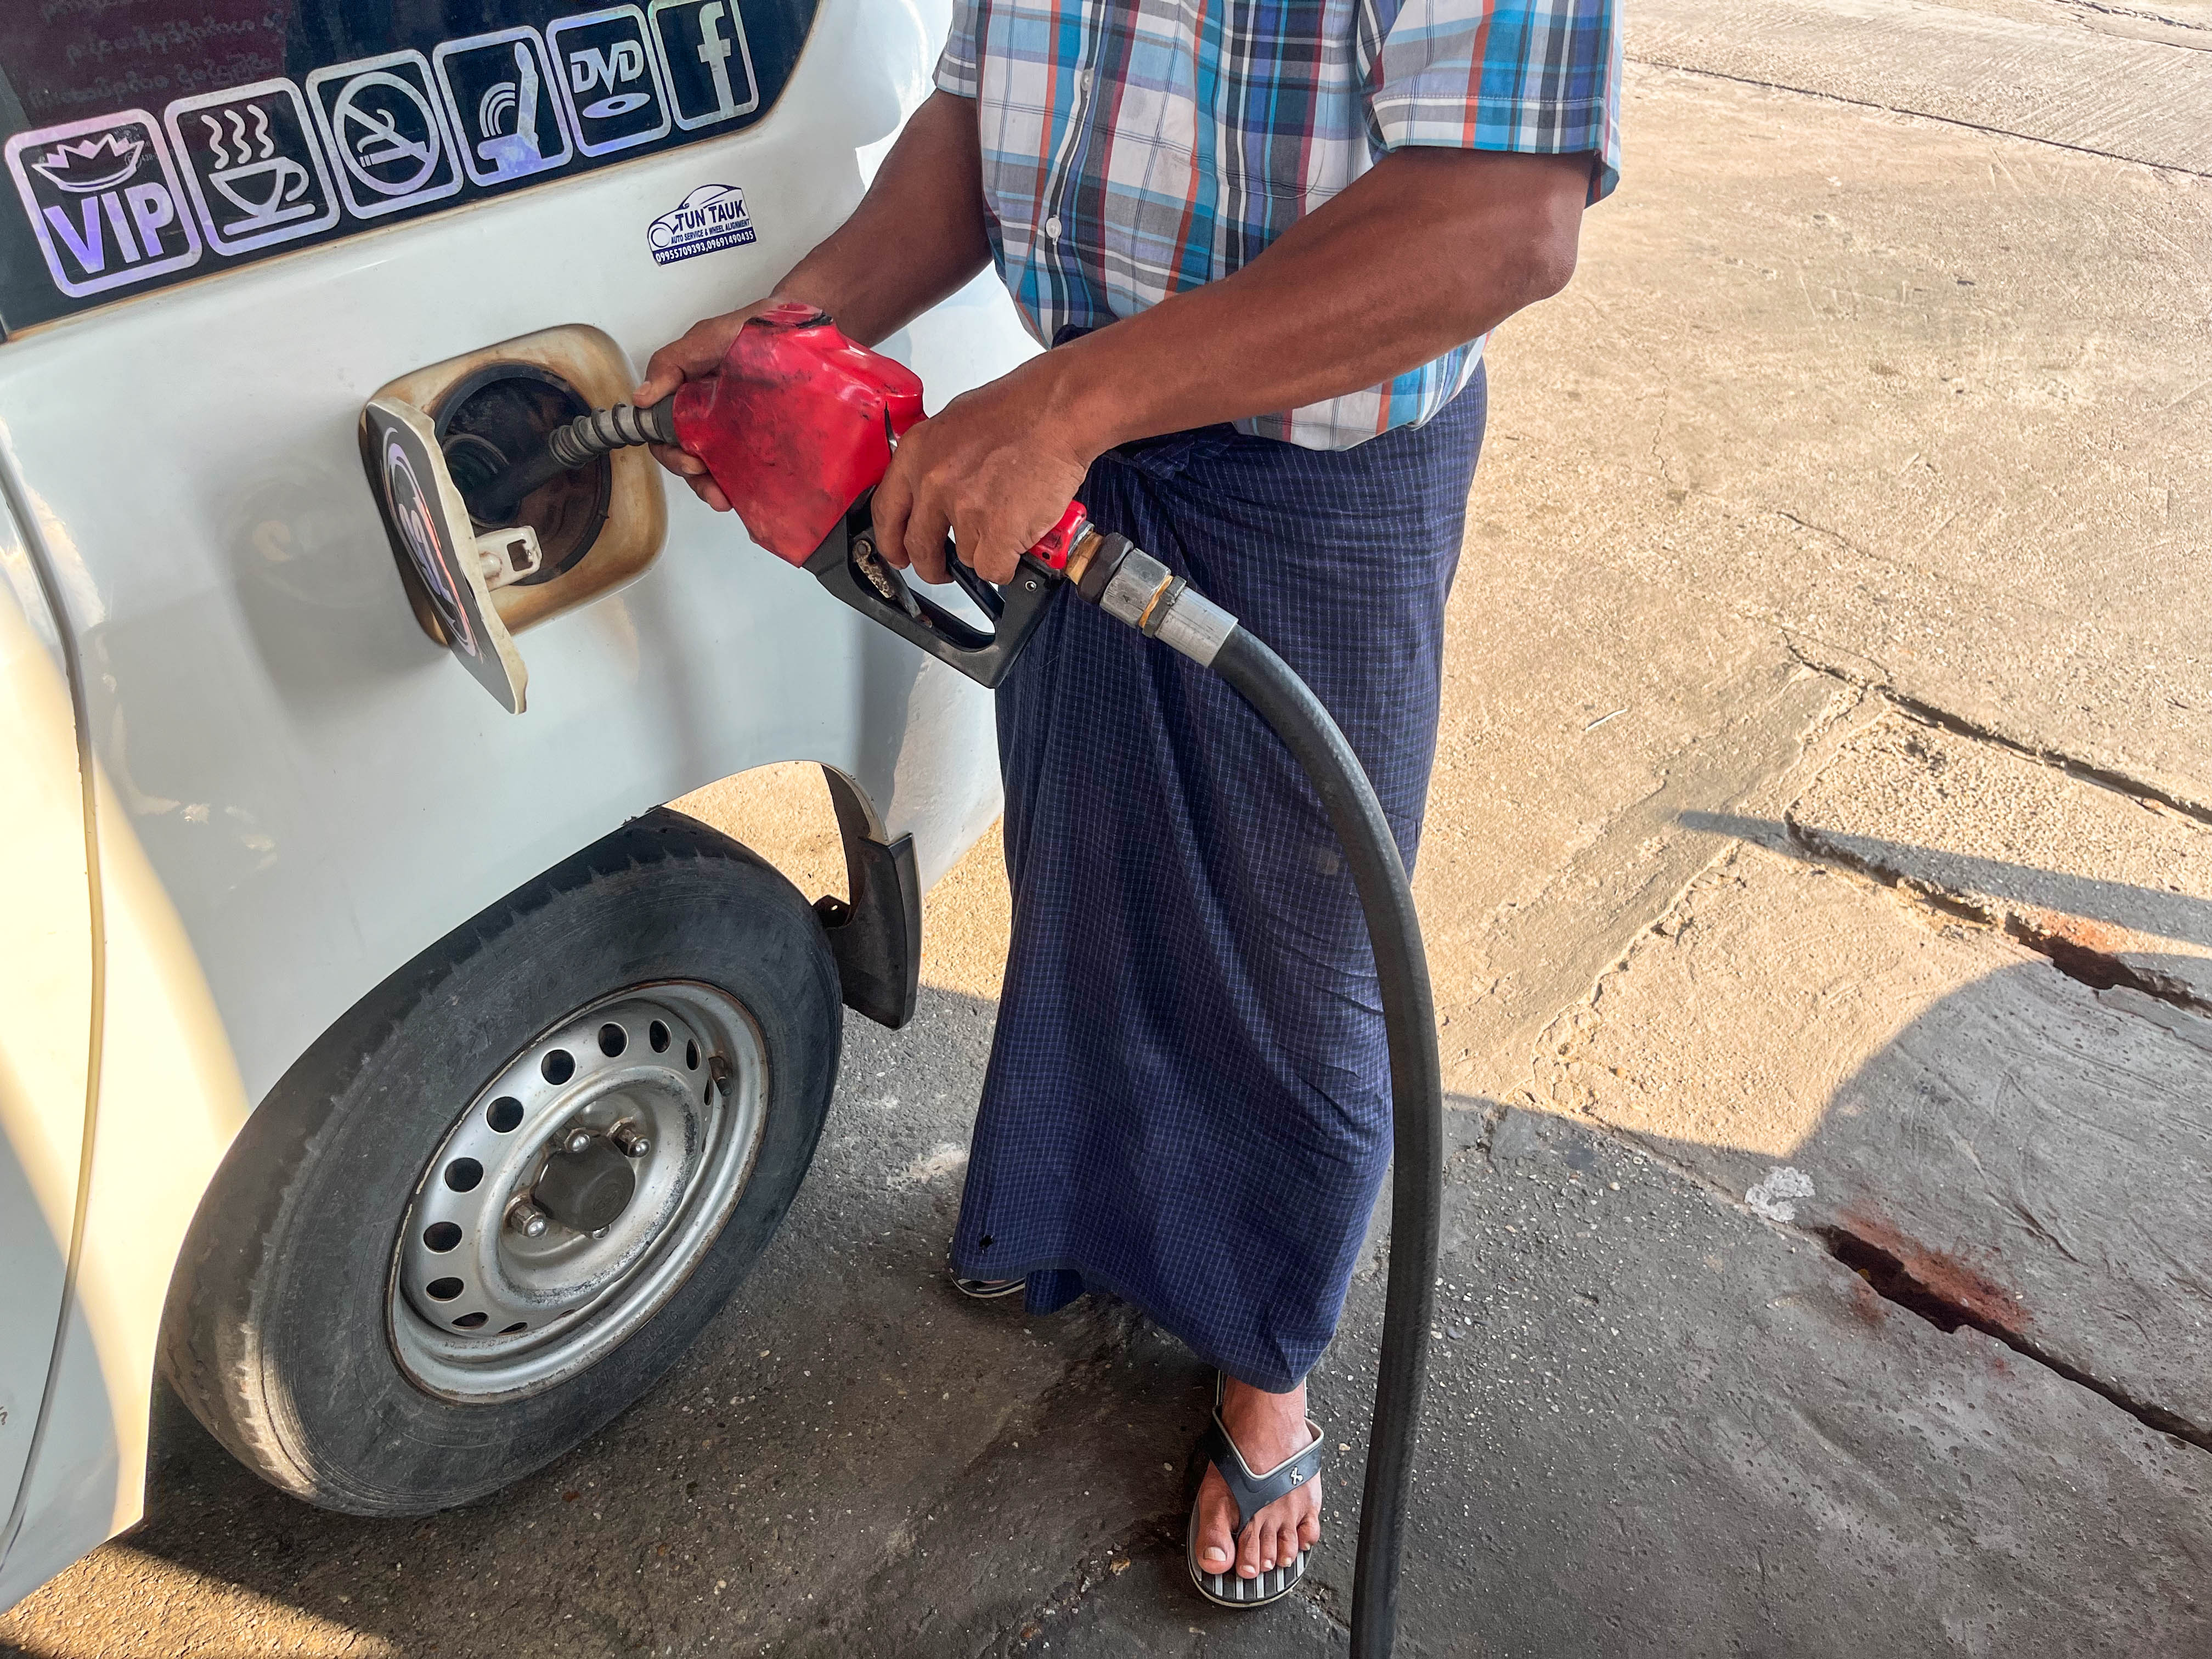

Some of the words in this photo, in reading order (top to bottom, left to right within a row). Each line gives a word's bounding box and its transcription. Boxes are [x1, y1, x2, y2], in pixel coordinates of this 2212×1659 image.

[569, 39, 645, 95] DVD
[43, 182, 175, 274] VIP
[671, 236, 684, 245] AUTO
[684, 231, 704, 241] SERVICE
[709, 225, 725, 235] WHEEL
[725, 218, 750, 231] ALIGNMENT
[675, 208, 706, 232] TUN
[708, 199, 747, 223] TAUK
